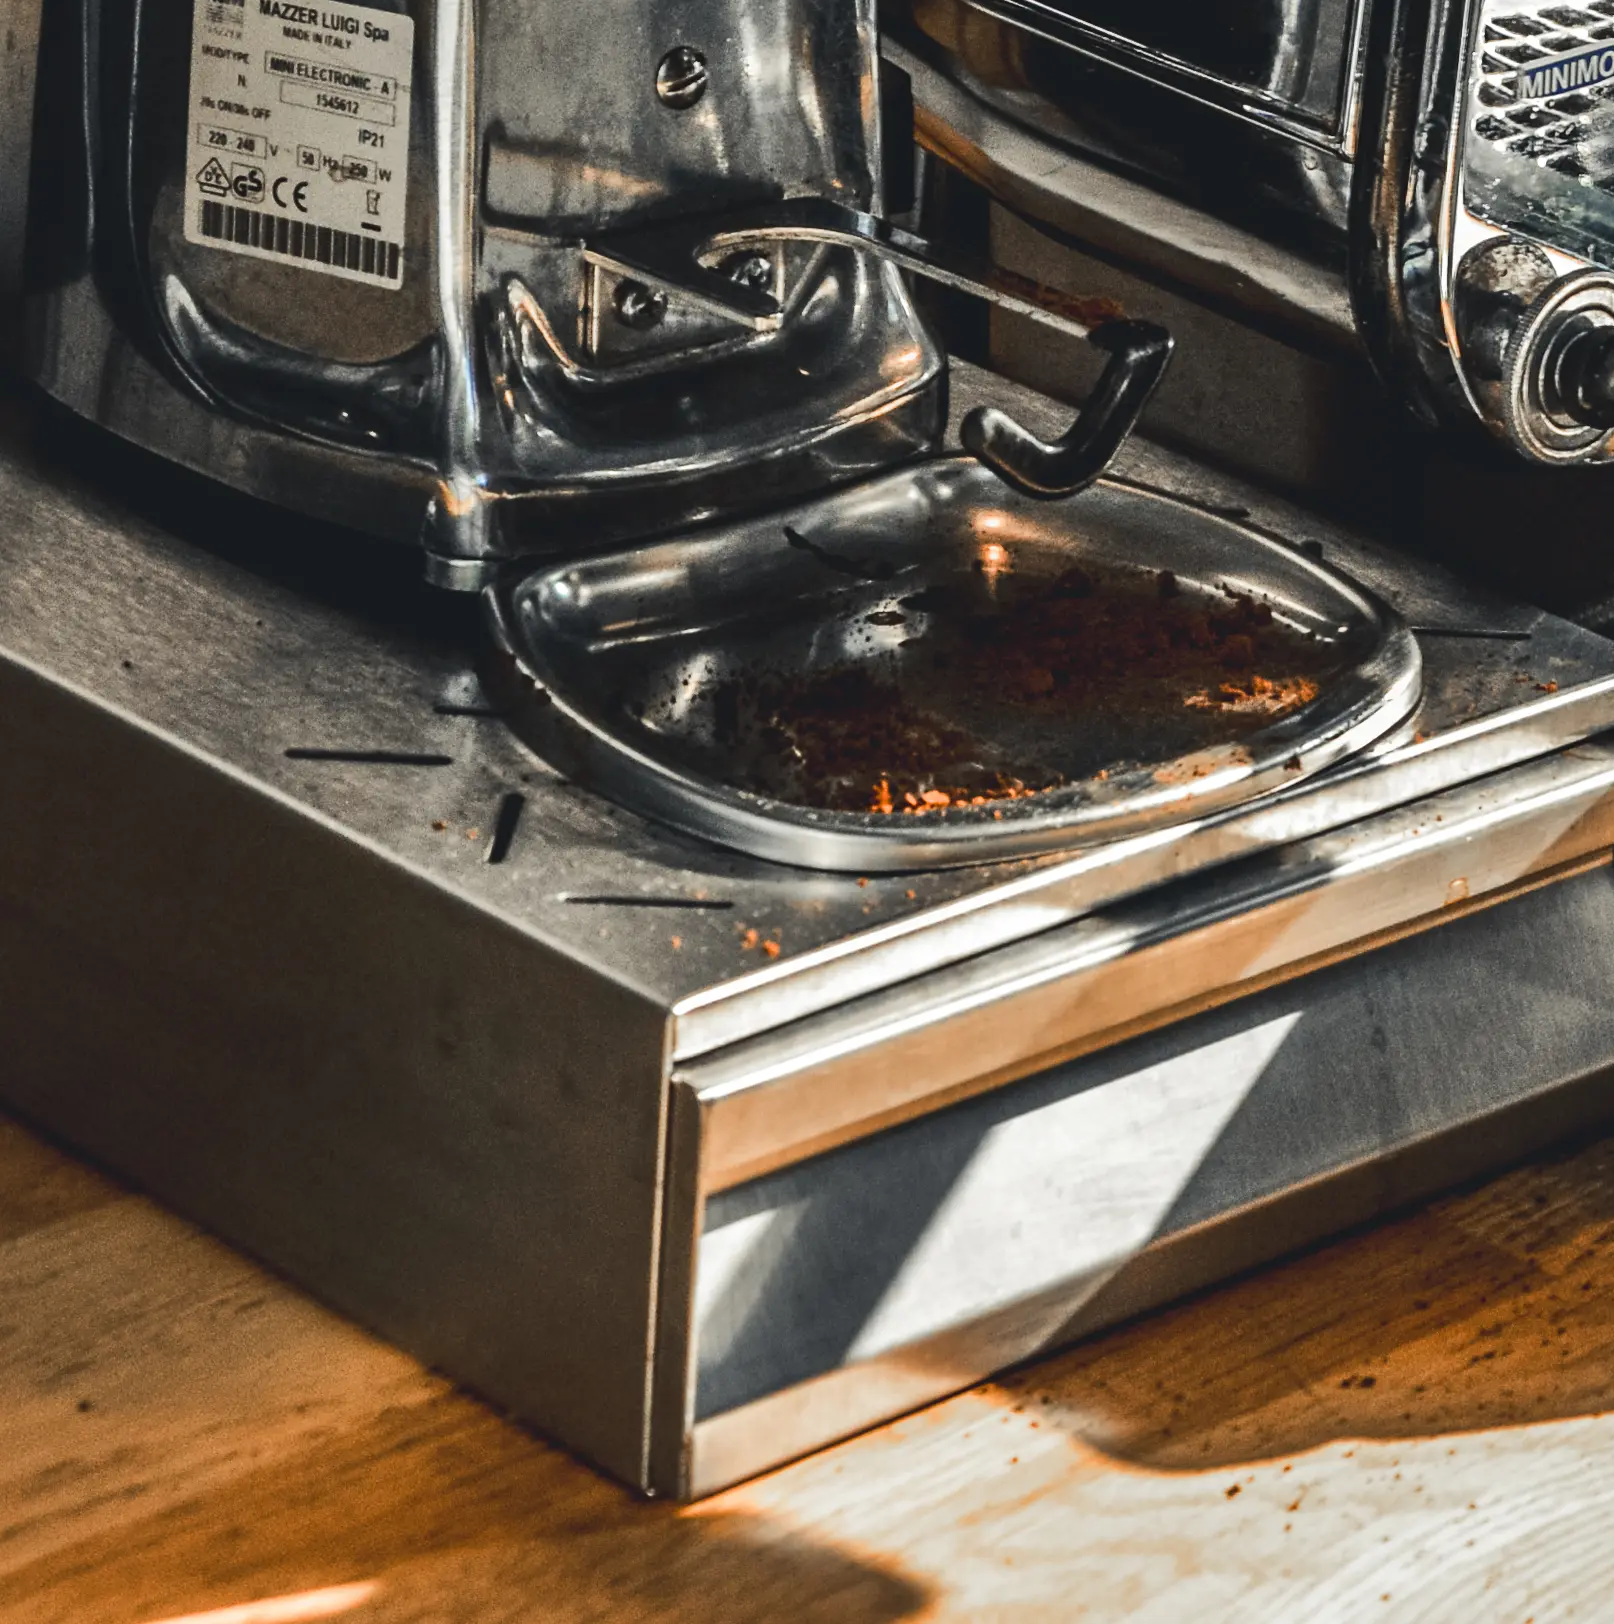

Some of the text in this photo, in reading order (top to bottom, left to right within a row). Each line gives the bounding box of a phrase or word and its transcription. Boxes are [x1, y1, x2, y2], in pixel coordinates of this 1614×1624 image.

[283, 26, 351, 49] MADE IN ITALY
[322, 12, 360, 35] LUIGI
[364, 21, 389, 42] Spa
[271, 57, 295, 74] MINI
[297, 63, 371, 91] ELECTRONIC
[381, 81, 390, 94] A
[252, 107, 271, 120] OFF
[270, 143, 278, 157] V
[358, 129, 385, 148] IP21
[302, 152, 314, 165] 50
[379, 168, 391, 182] W
[272, 177, 309, 213] CE
